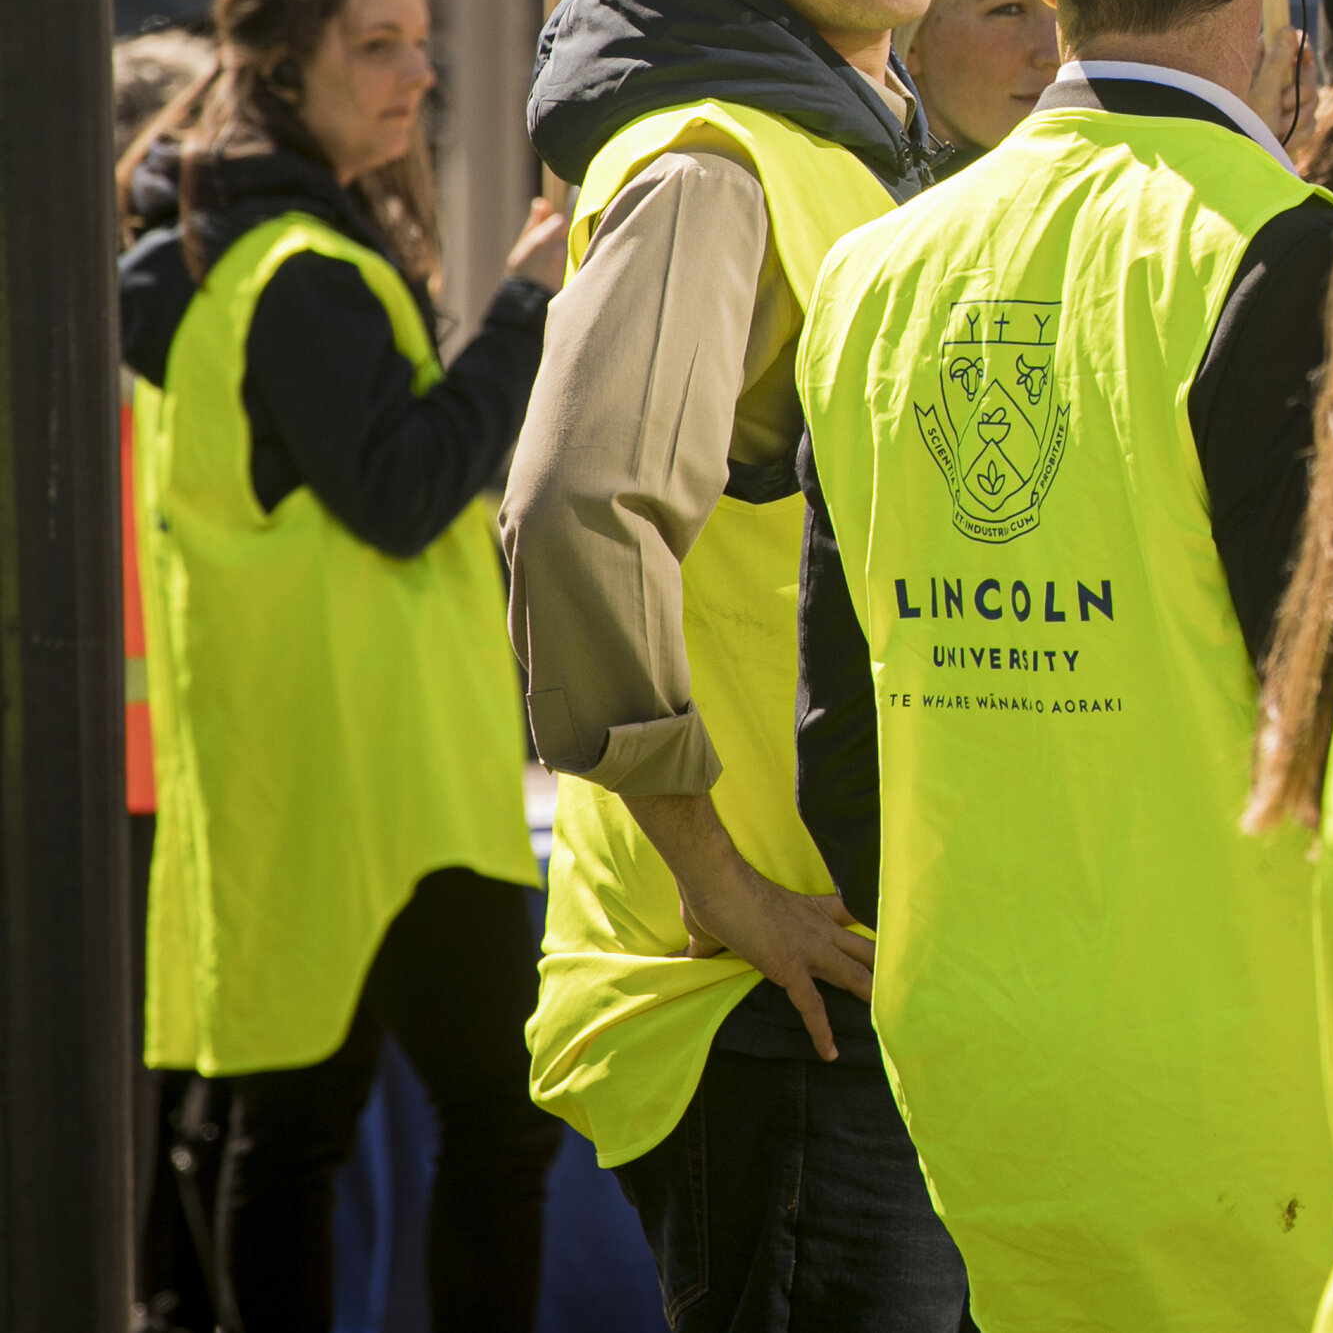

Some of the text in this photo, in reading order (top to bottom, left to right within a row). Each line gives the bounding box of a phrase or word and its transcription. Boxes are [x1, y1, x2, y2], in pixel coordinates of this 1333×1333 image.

[1040, 424, 1064, 490] PROBITATE
[894, 577, 1114, 622] LINCOLN
[933, 646, 1079, 672] UNIVERSITY
[889, 694, 911, 707] TE
[922, 694, 970, 709] WHARE
[1051, 698, 1122, 714] AORAKI
